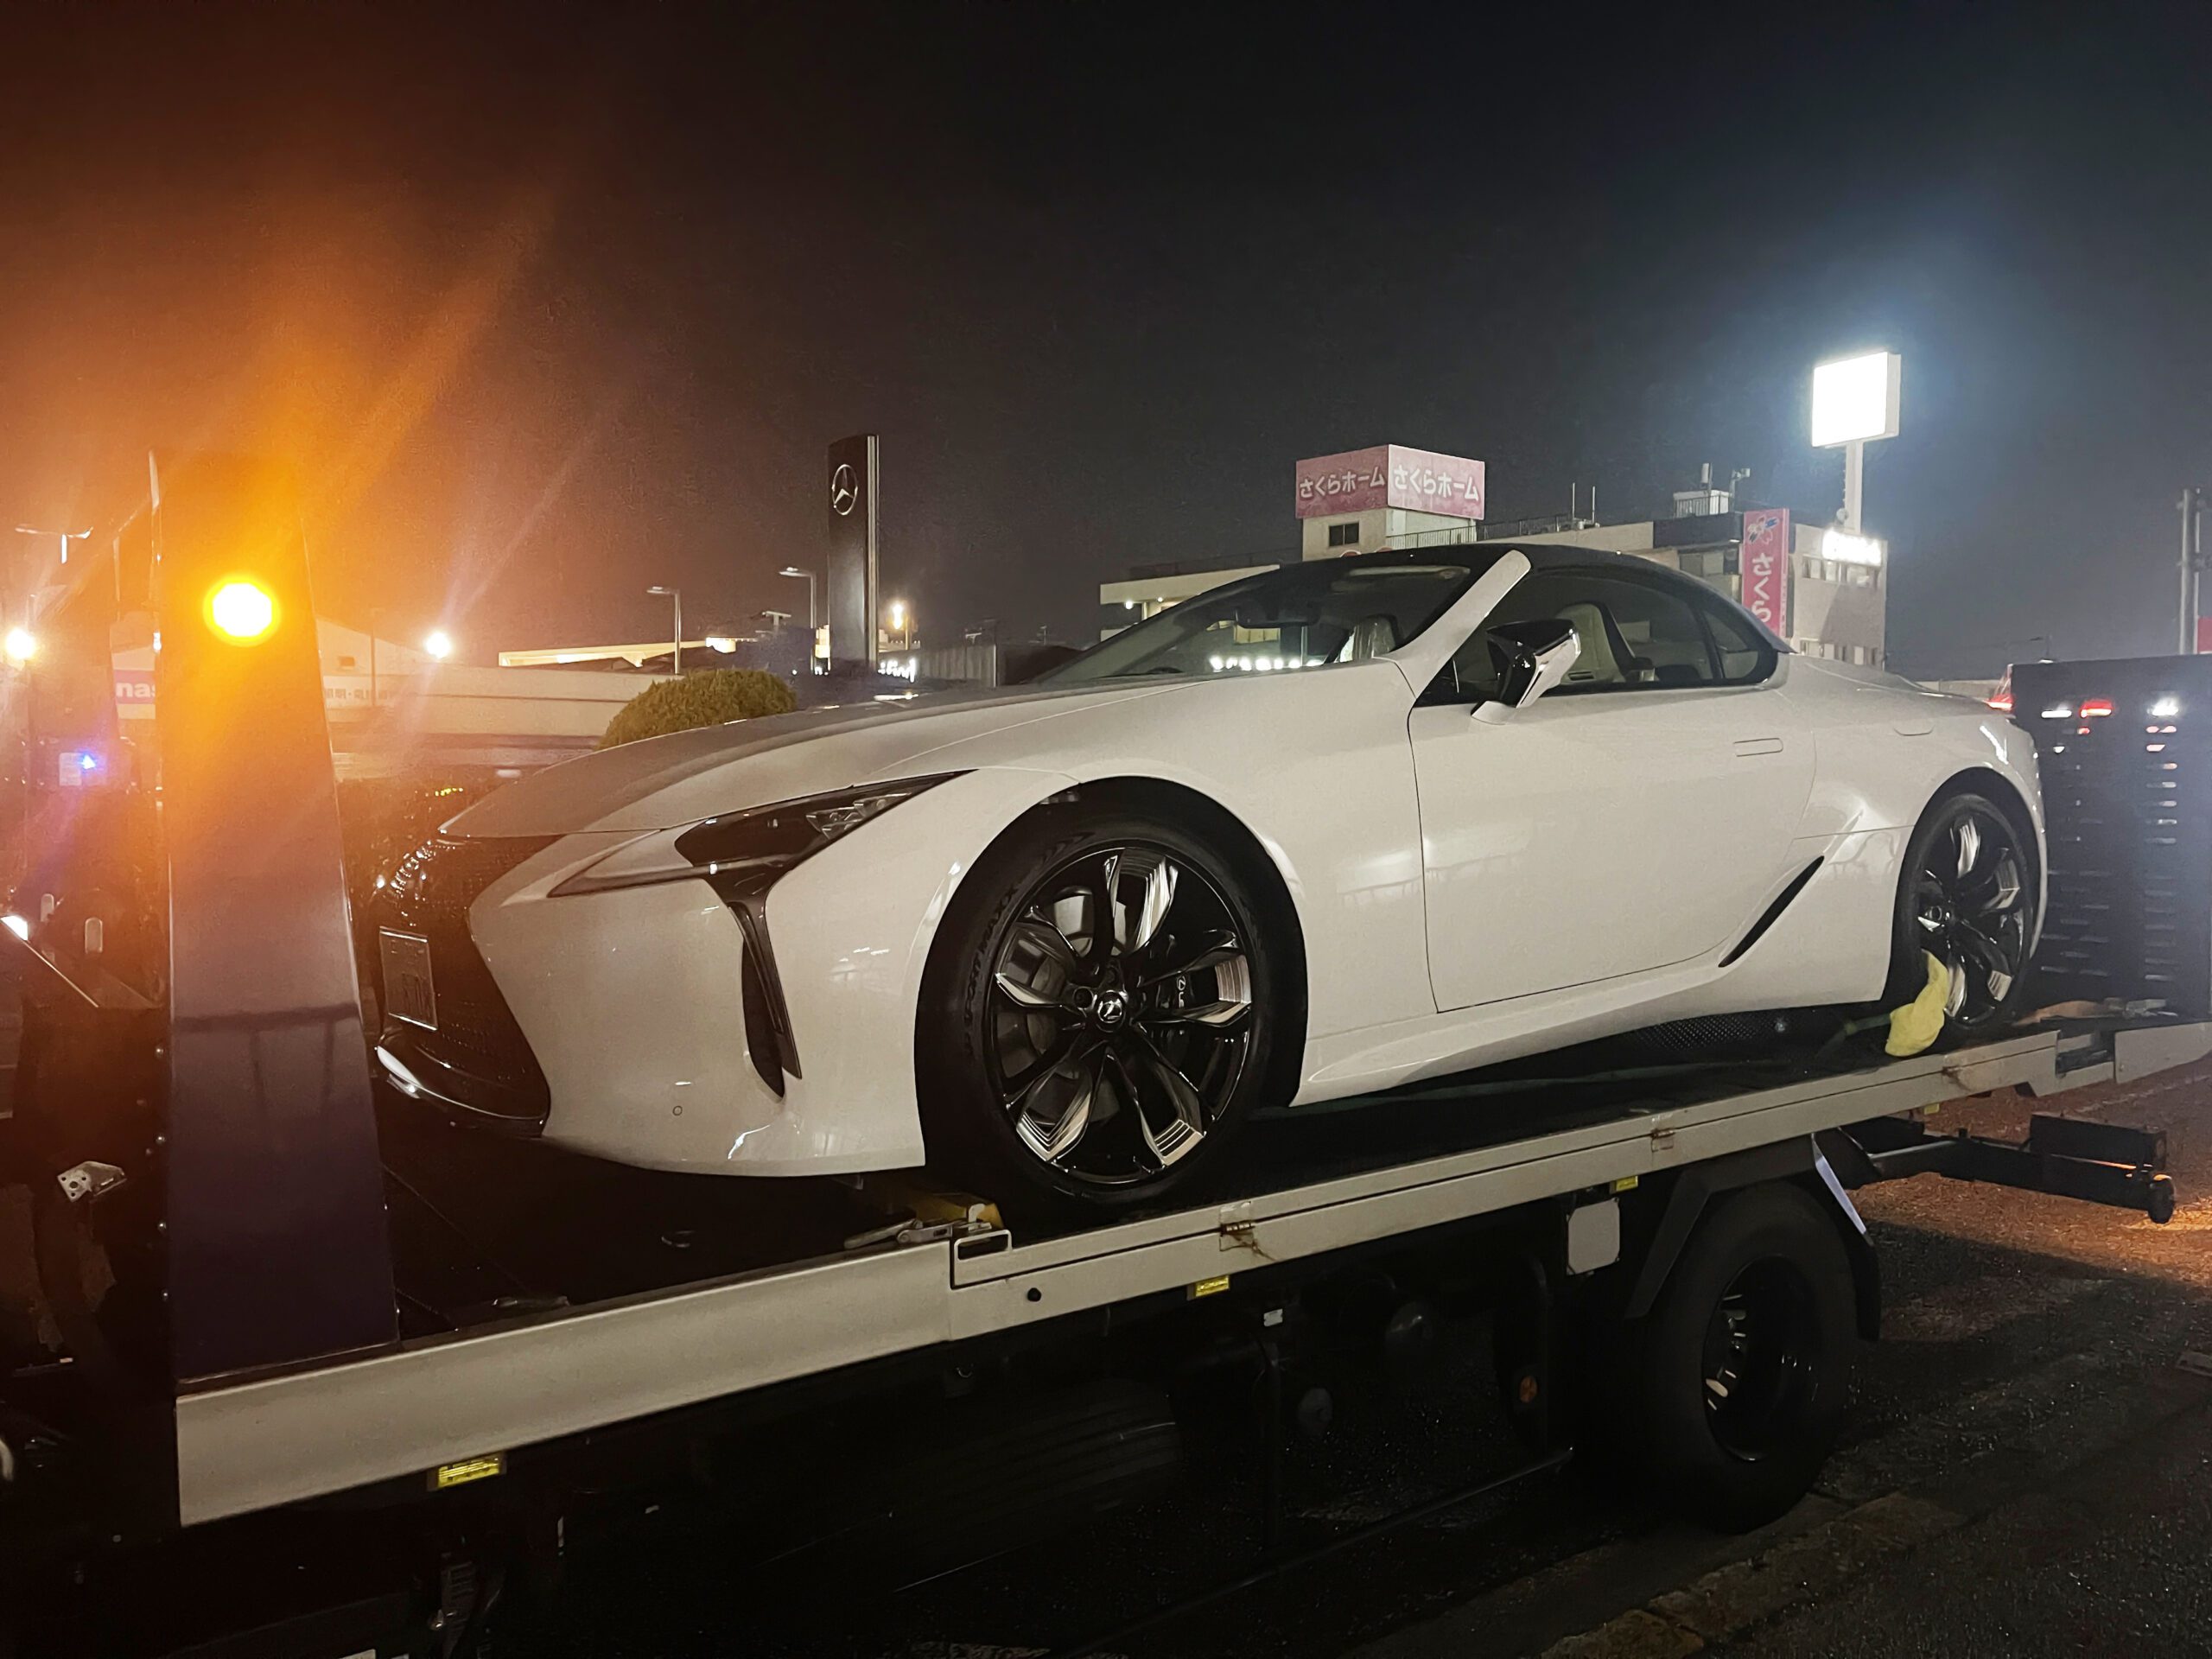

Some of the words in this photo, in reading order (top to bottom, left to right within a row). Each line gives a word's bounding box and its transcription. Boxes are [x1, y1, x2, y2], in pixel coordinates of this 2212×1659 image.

[1299, 466, 1386, 499] さくらホーム
[1393, 464, 1480, 502] さくらホーム
